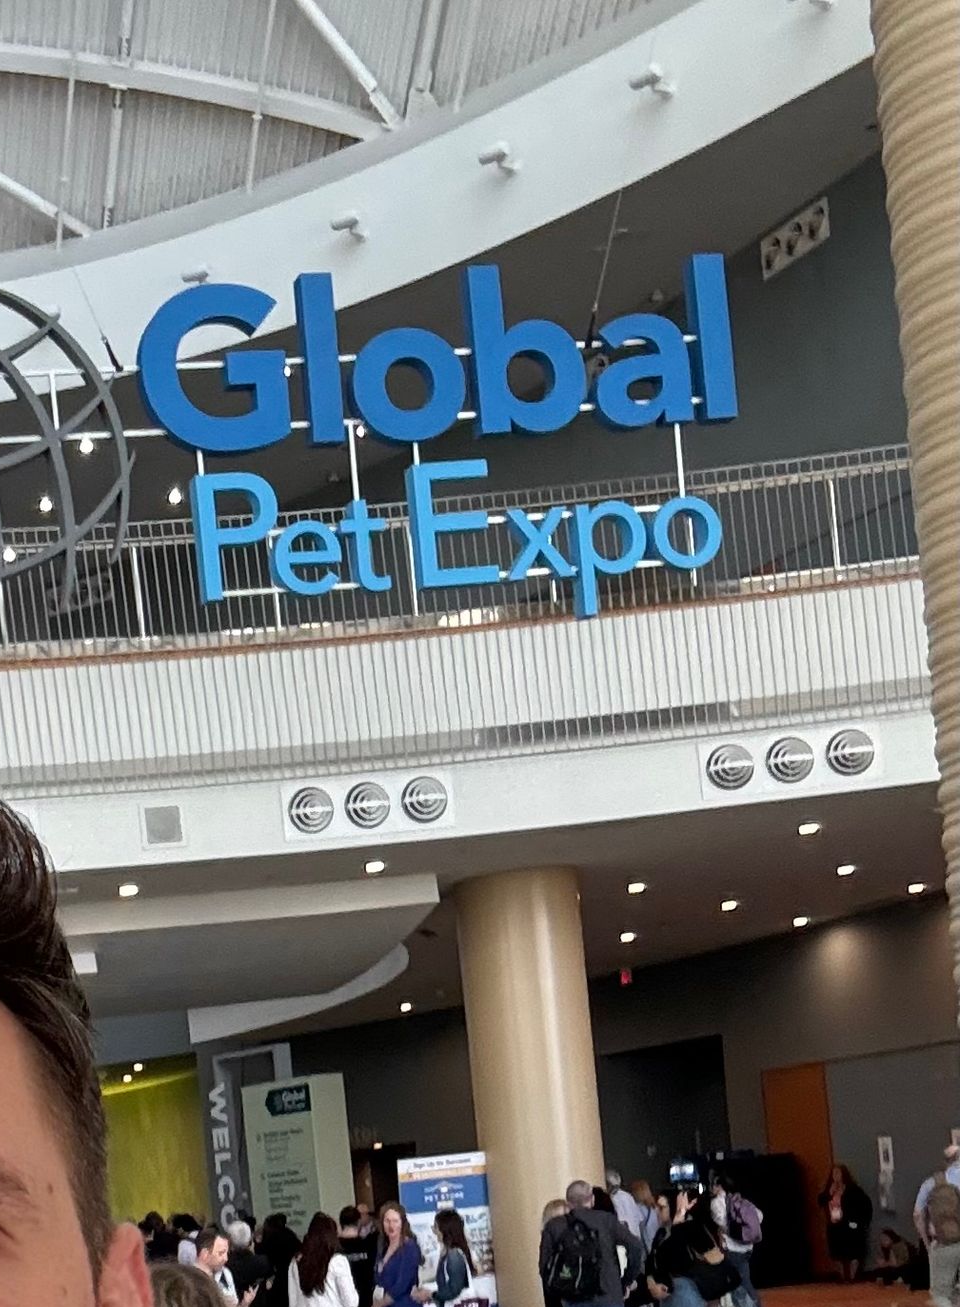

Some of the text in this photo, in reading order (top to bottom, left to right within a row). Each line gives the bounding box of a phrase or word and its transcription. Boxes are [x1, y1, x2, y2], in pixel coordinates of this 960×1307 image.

[137, 253, 738, 453] Global
[189, 458, 723, 619] Pet Expo
